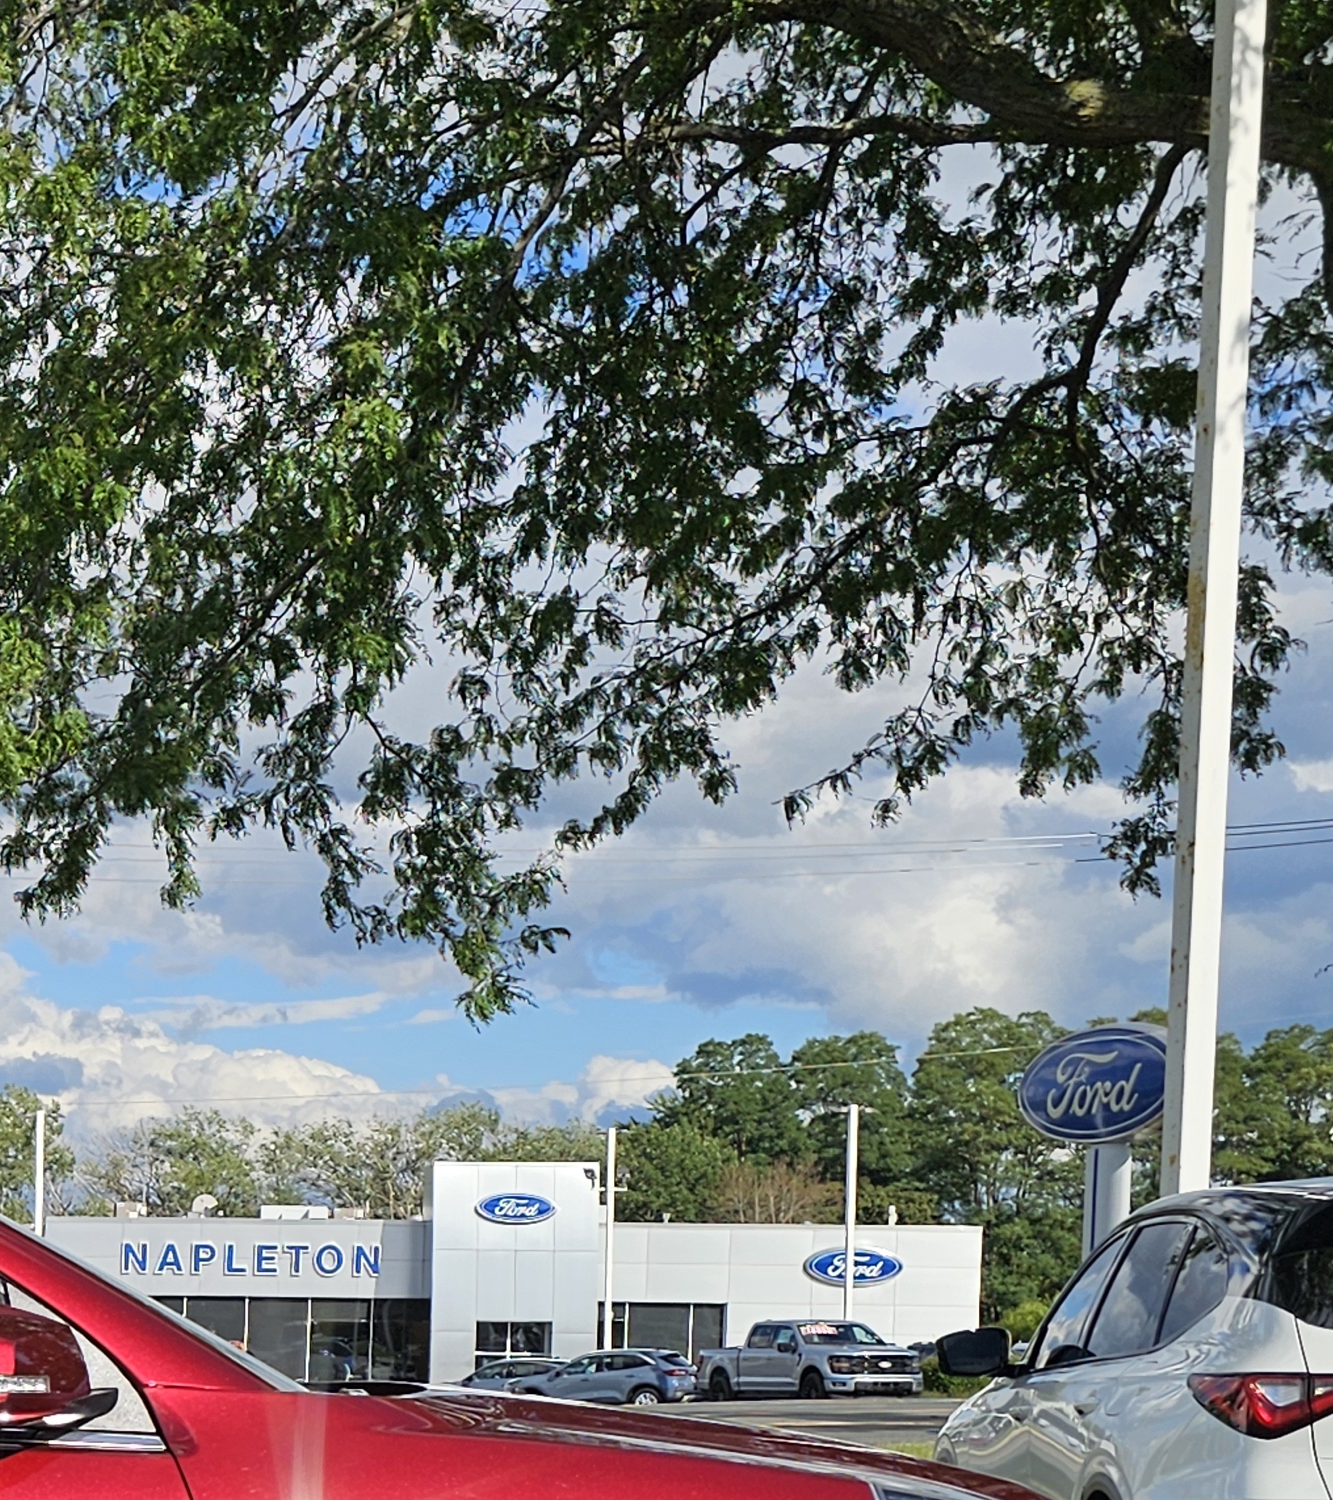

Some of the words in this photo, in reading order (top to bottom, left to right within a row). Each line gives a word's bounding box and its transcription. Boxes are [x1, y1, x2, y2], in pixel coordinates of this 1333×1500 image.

[1045, 1050, 1143, 1119] Ford
[494, 1198, 540, 1217] Ford
[121, 1241, 382, 1278] NAPLETON
[826, 1254, 884, 1278] Frd
